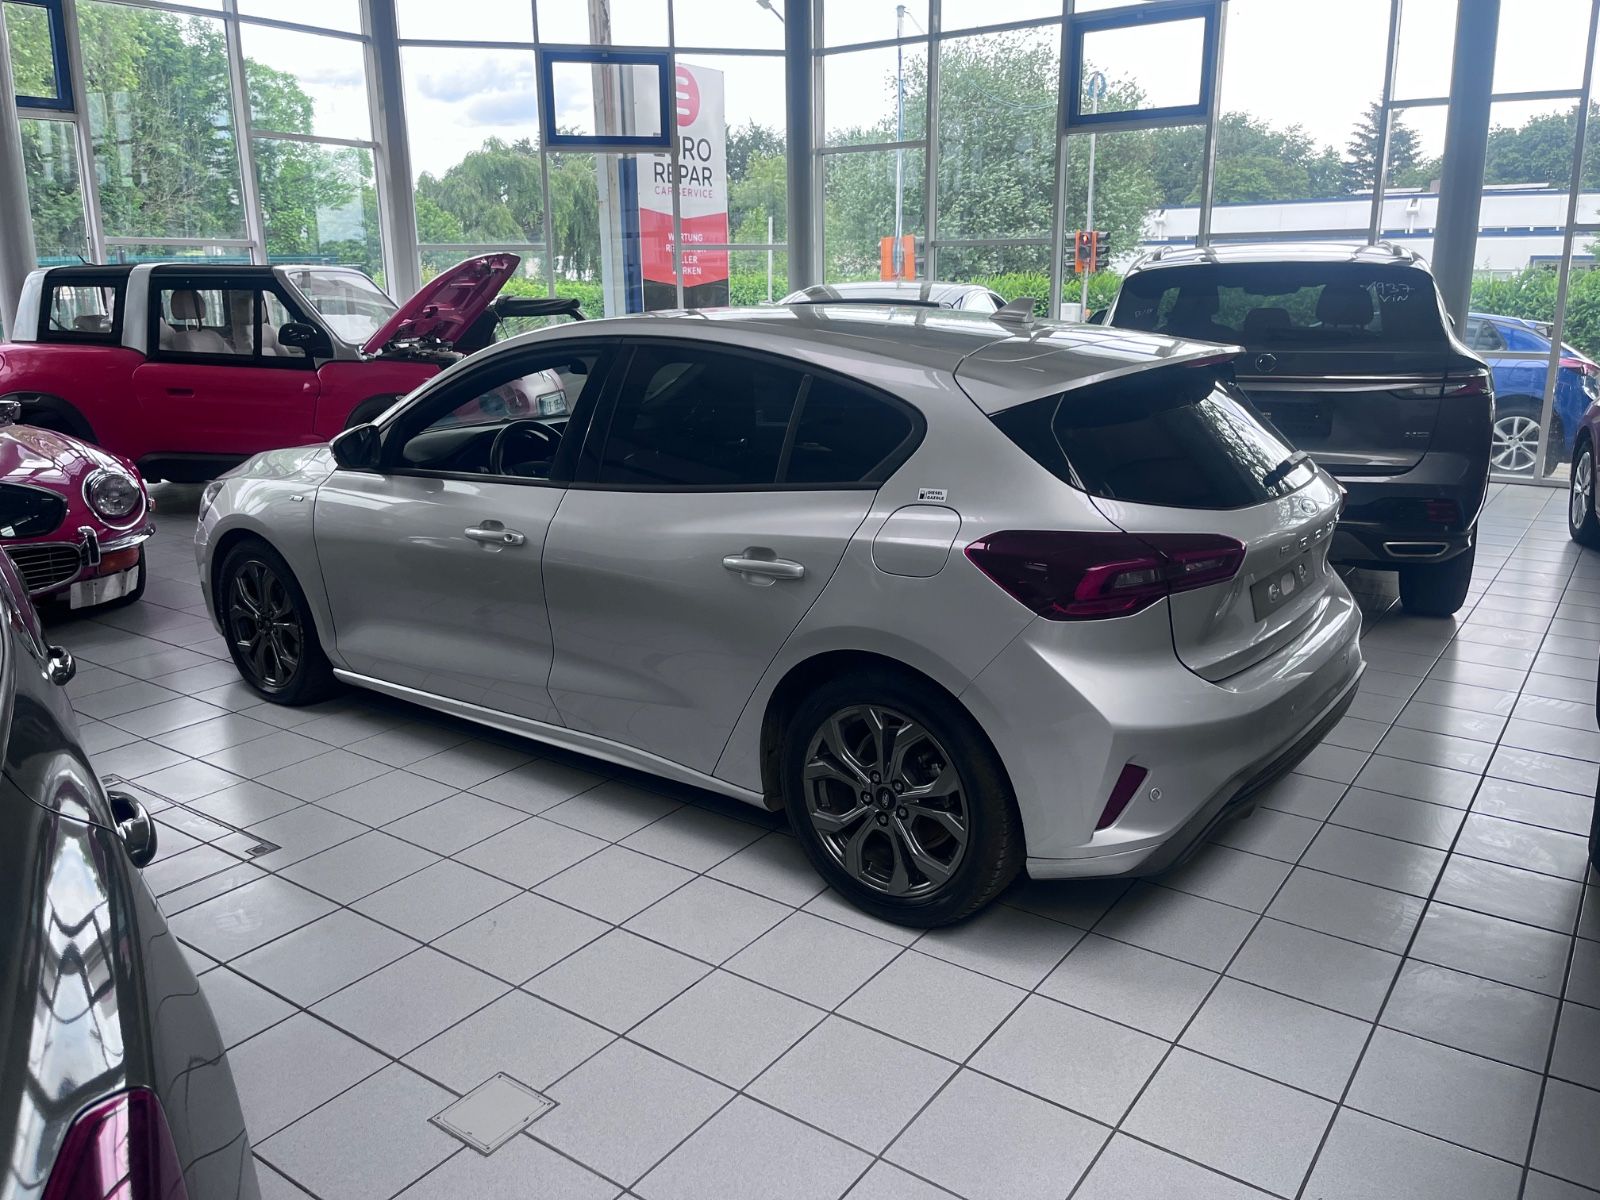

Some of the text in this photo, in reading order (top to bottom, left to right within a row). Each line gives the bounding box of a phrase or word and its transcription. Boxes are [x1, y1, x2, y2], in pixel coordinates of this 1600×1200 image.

[653, 136, 711, 162] RO
[680, 187, 713, 199] ERVICE
[667, 232, 703, 242] WRTUNG
[672, 266, 702, 275] RKEN
